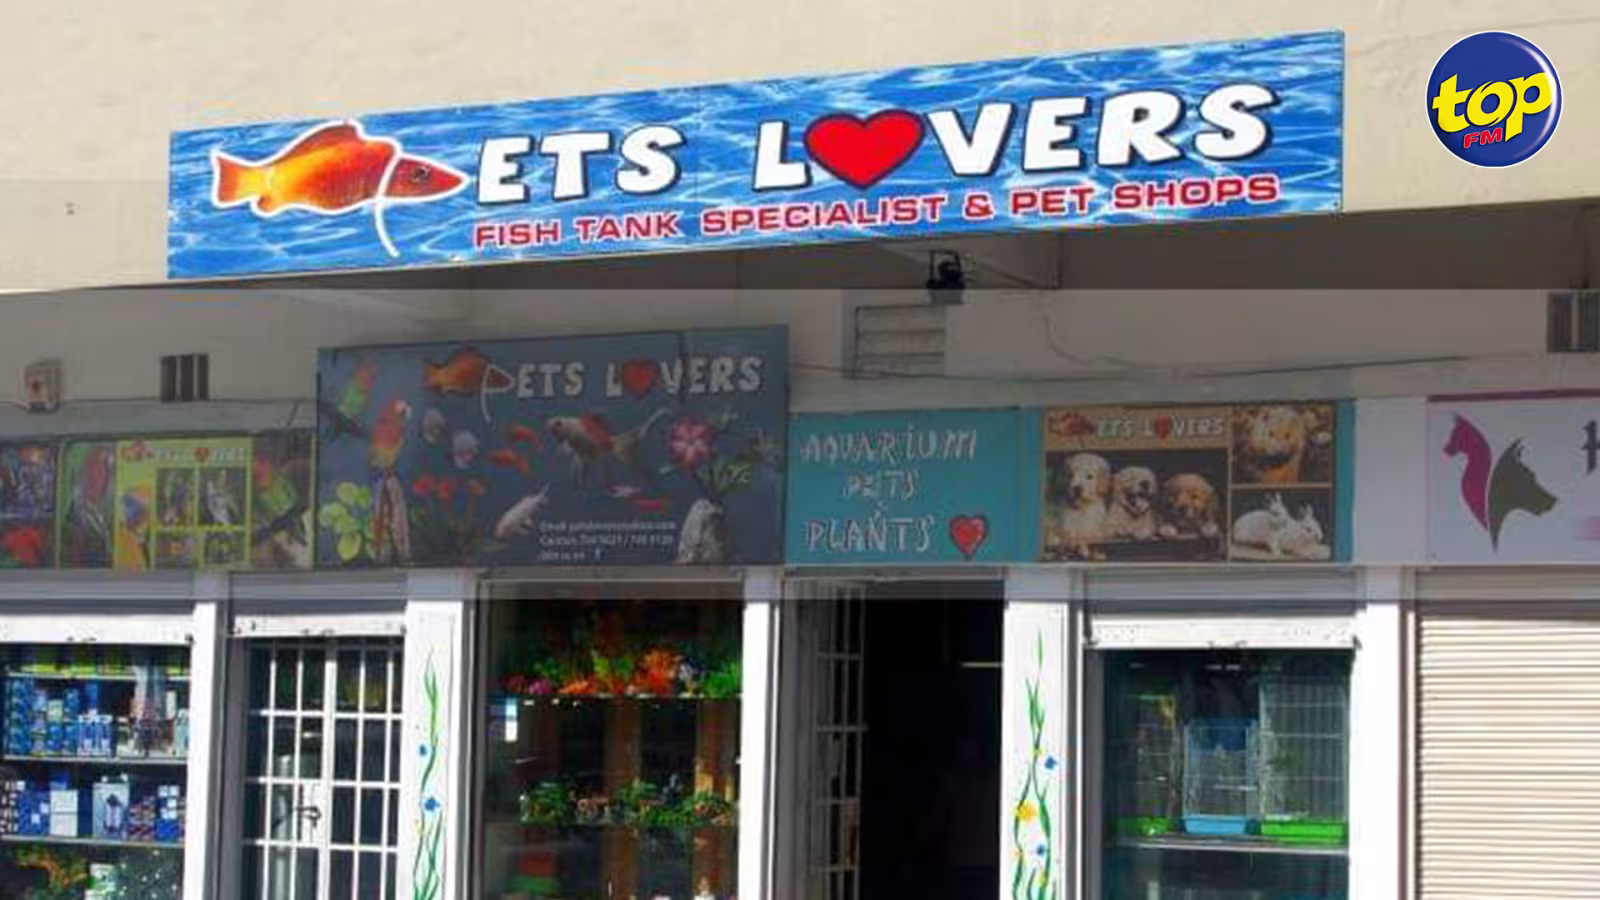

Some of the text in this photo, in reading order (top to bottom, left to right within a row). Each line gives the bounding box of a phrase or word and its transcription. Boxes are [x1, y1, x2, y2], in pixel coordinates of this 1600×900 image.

[474, 174, 1281, 249] FISH TANK SPECIALIST & PET SHOPS
[805, 513, 936, 553] PLANTS
